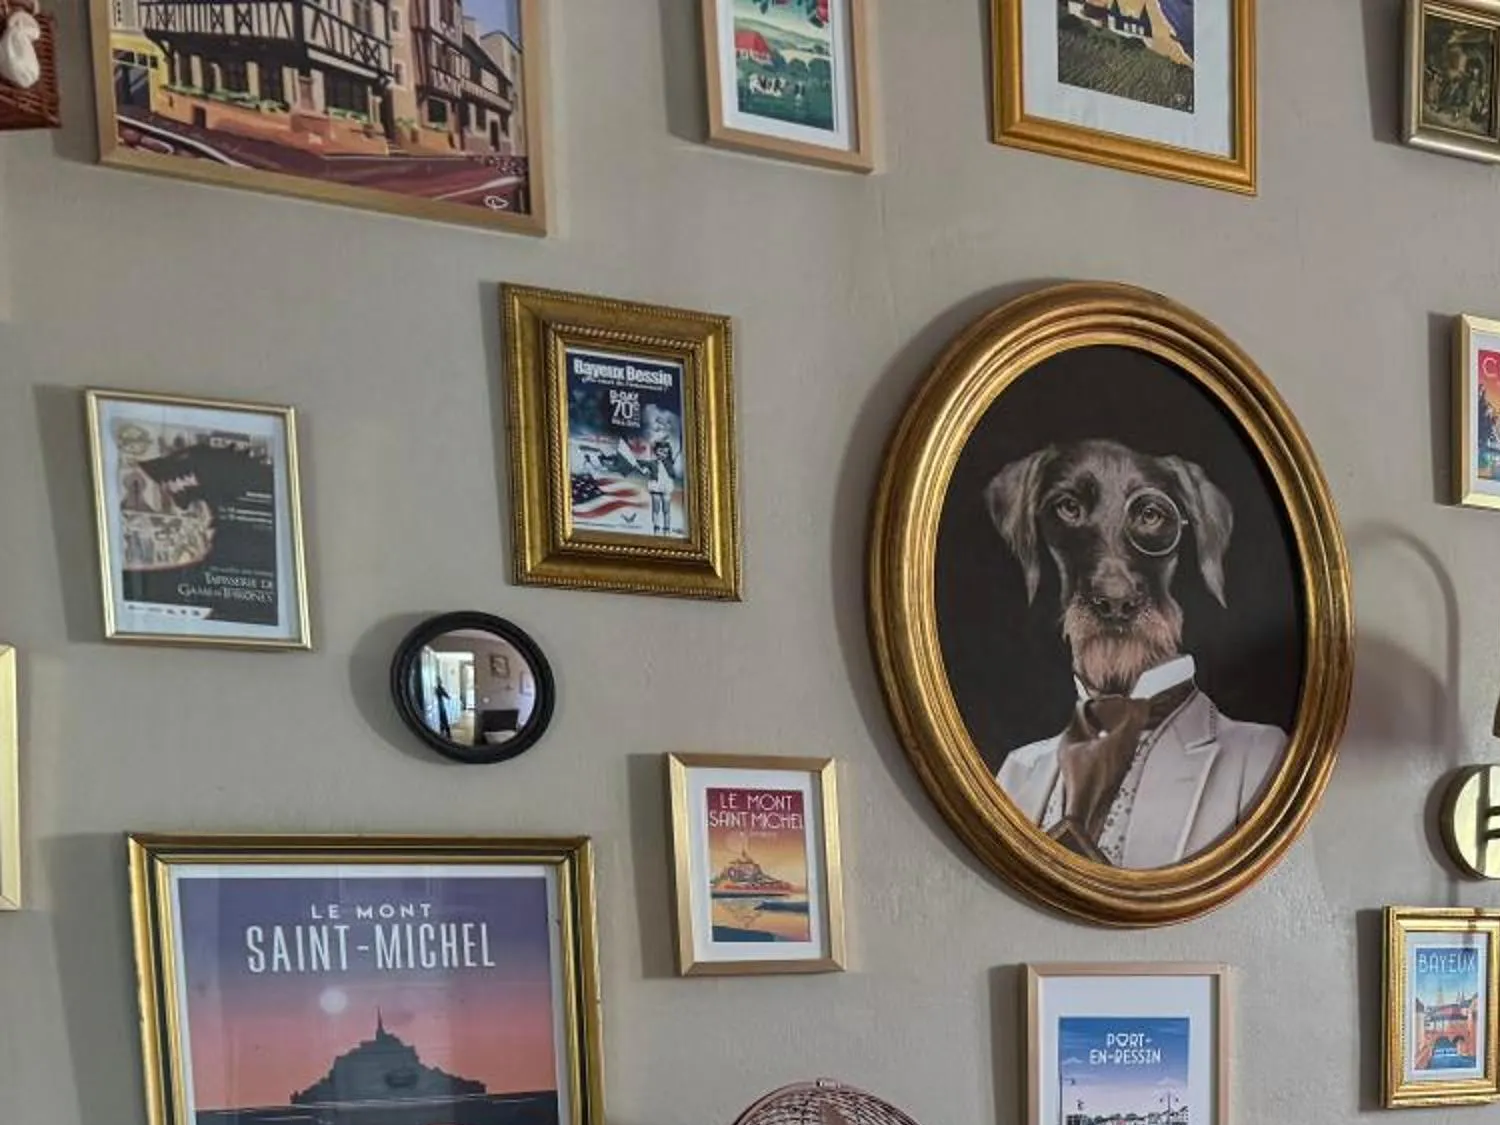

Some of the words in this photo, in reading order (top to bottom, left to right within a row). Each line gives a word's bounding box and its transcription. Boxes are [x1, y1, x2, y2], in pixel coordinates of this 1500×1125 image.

[573, 358, 625, 378] Bayeux
[626, 366, 672, 387] Bessin
[610, 400, 633, 419] 70
[720, 792, 738, 809] LE
[747, 793, 794, 811] MONT
[708, 810, 748, 828] SAINT
[751, 812, 803, 829] MICHEL
[311, 904, 340, 919] LE
[356, 903, 431, 919] MONT
[246, 922, 496, 973] SAINT-MICHEL
[1419, 953, 1475, 974] BAYEUX
